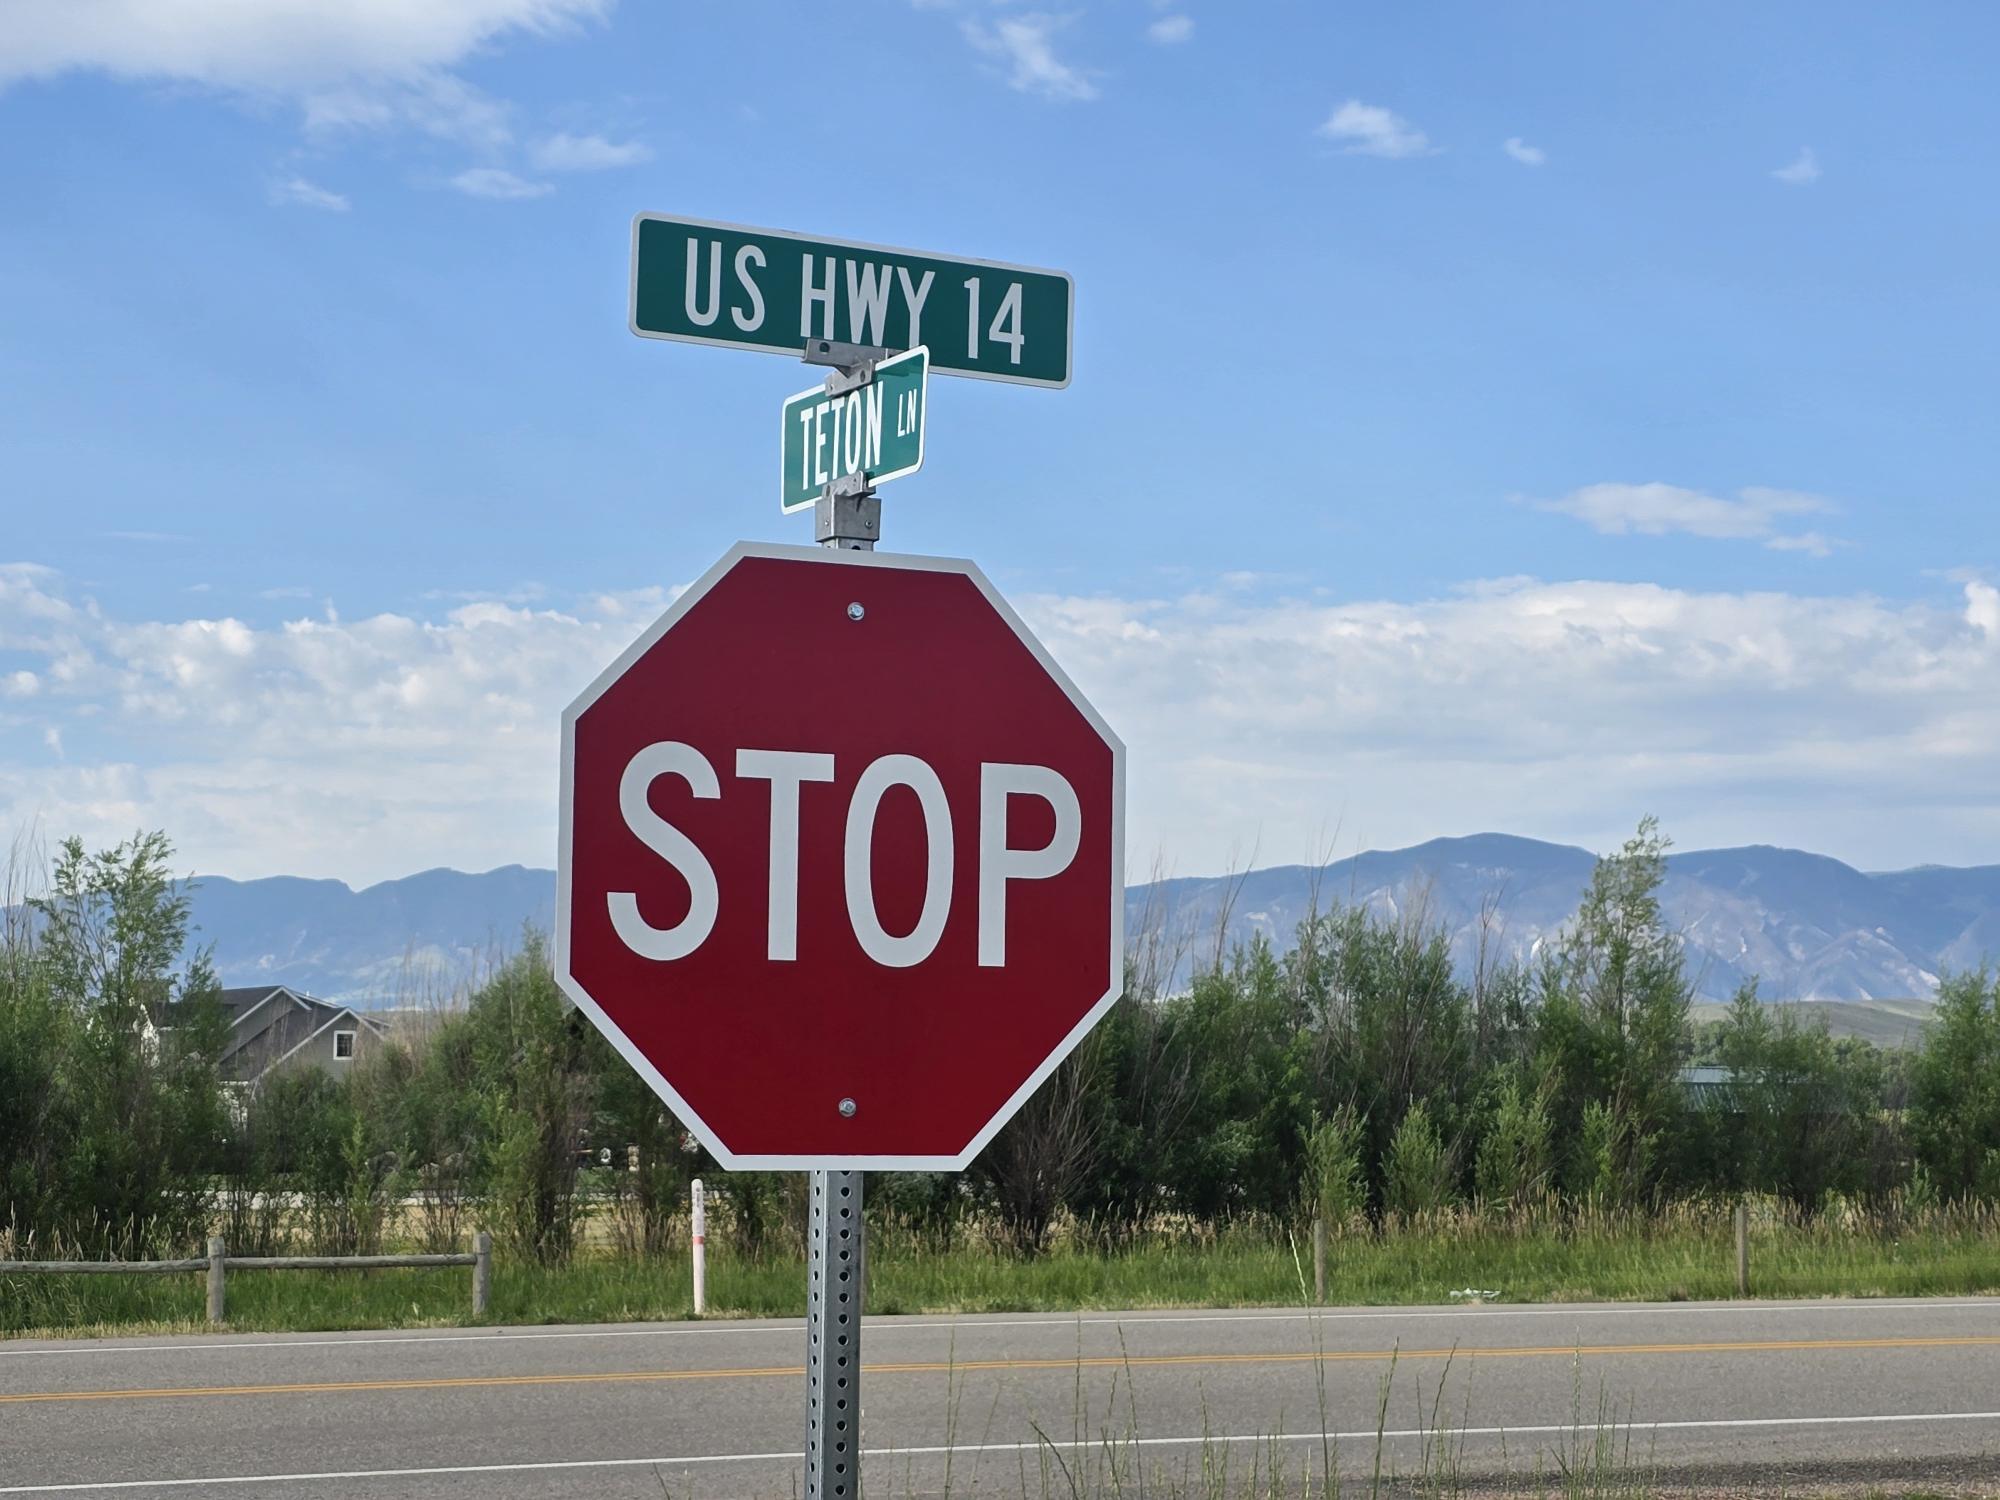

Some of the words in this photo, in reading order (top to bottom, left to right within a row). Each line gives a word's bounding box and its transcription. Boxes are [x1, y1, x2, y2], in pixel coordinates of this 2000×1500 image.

[685, 237, 767, 332] US
[801, 253, 935, 350] HWY
[963, 277, 1025, 365] 14
[800, 381, 884, 490] TETON
[897, 388, 918, 438] LN
[606, 740, 1082, 968] STOP
